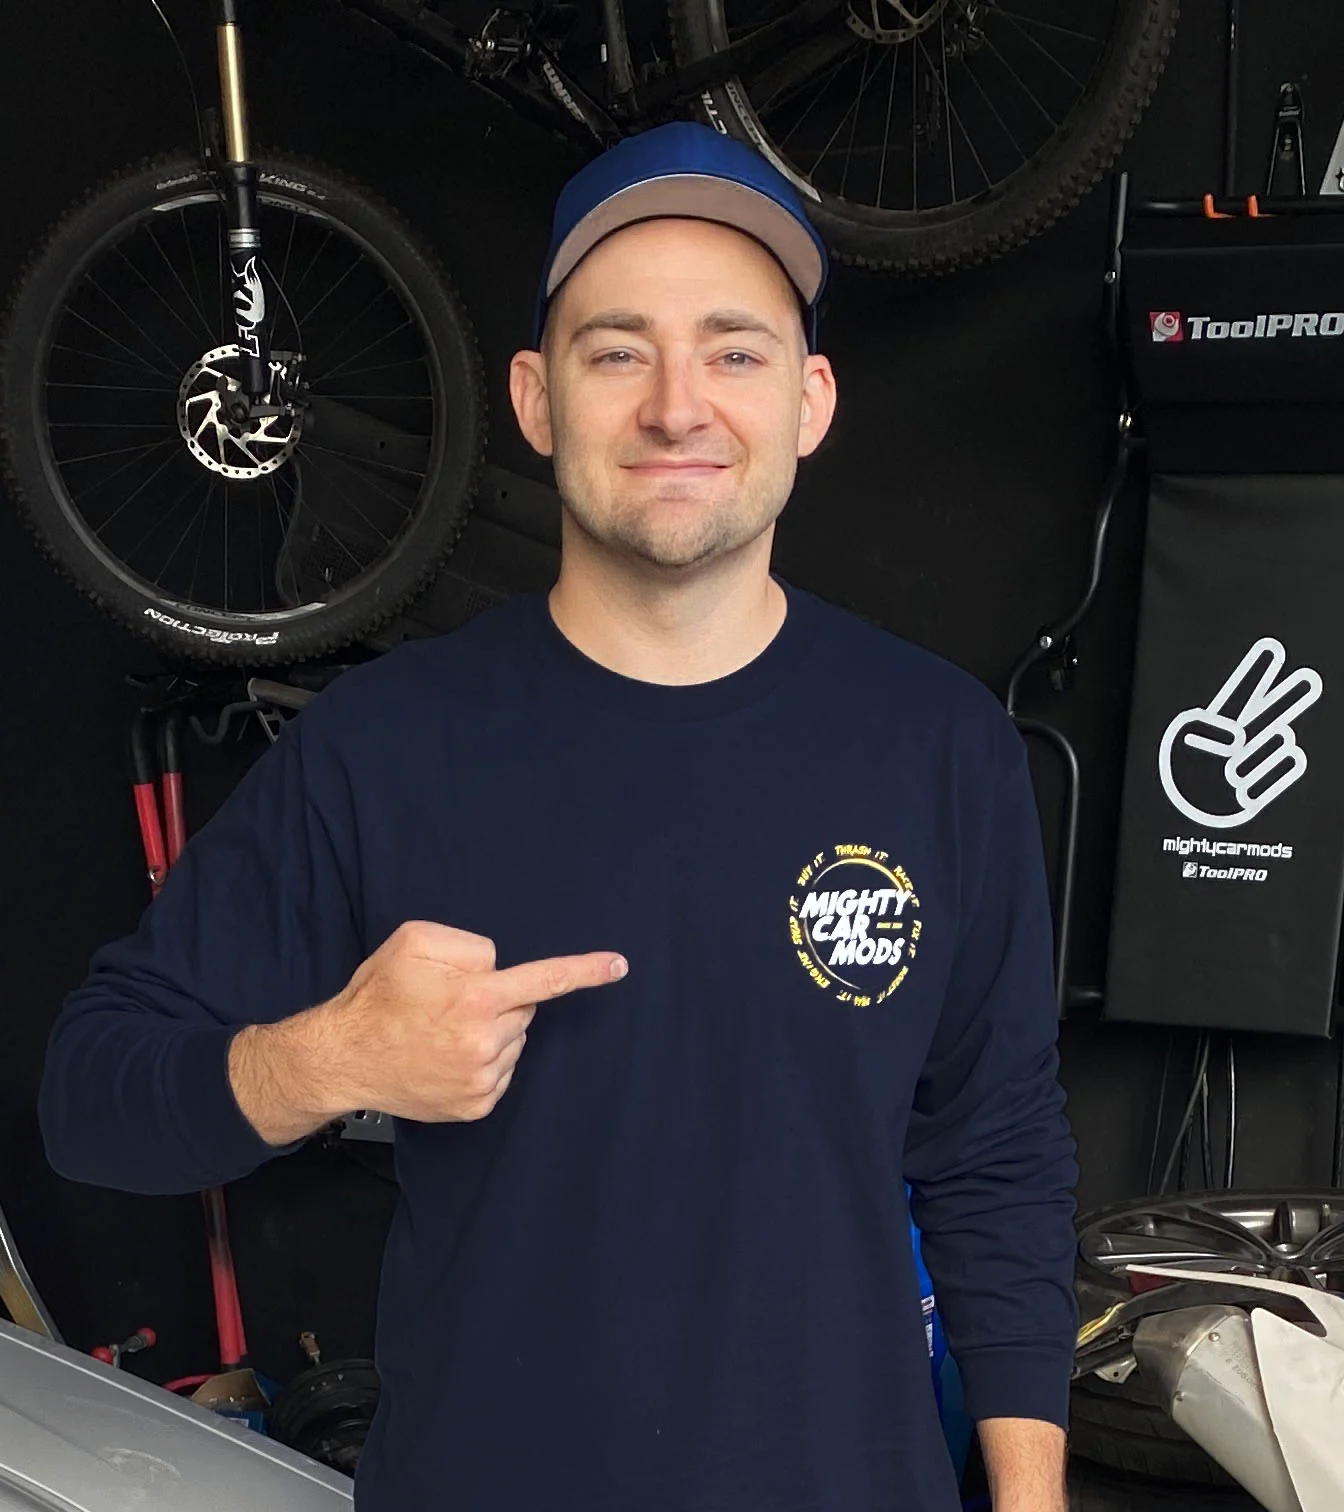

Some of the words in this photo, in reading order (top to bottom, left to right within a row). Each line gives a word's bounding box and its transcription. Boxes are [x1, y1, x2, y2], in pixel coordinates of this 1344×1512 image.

[834, 844, 871, 857] THRASH
[1163, 837, 1293, 859] mightycarmods
[1199, 865, 1268, 882] ToolPRO
[799, 888, 913, 919] MIGHTY
[812, 913, 870, 942] CAR
[828, 937, 905, 966] MODS
